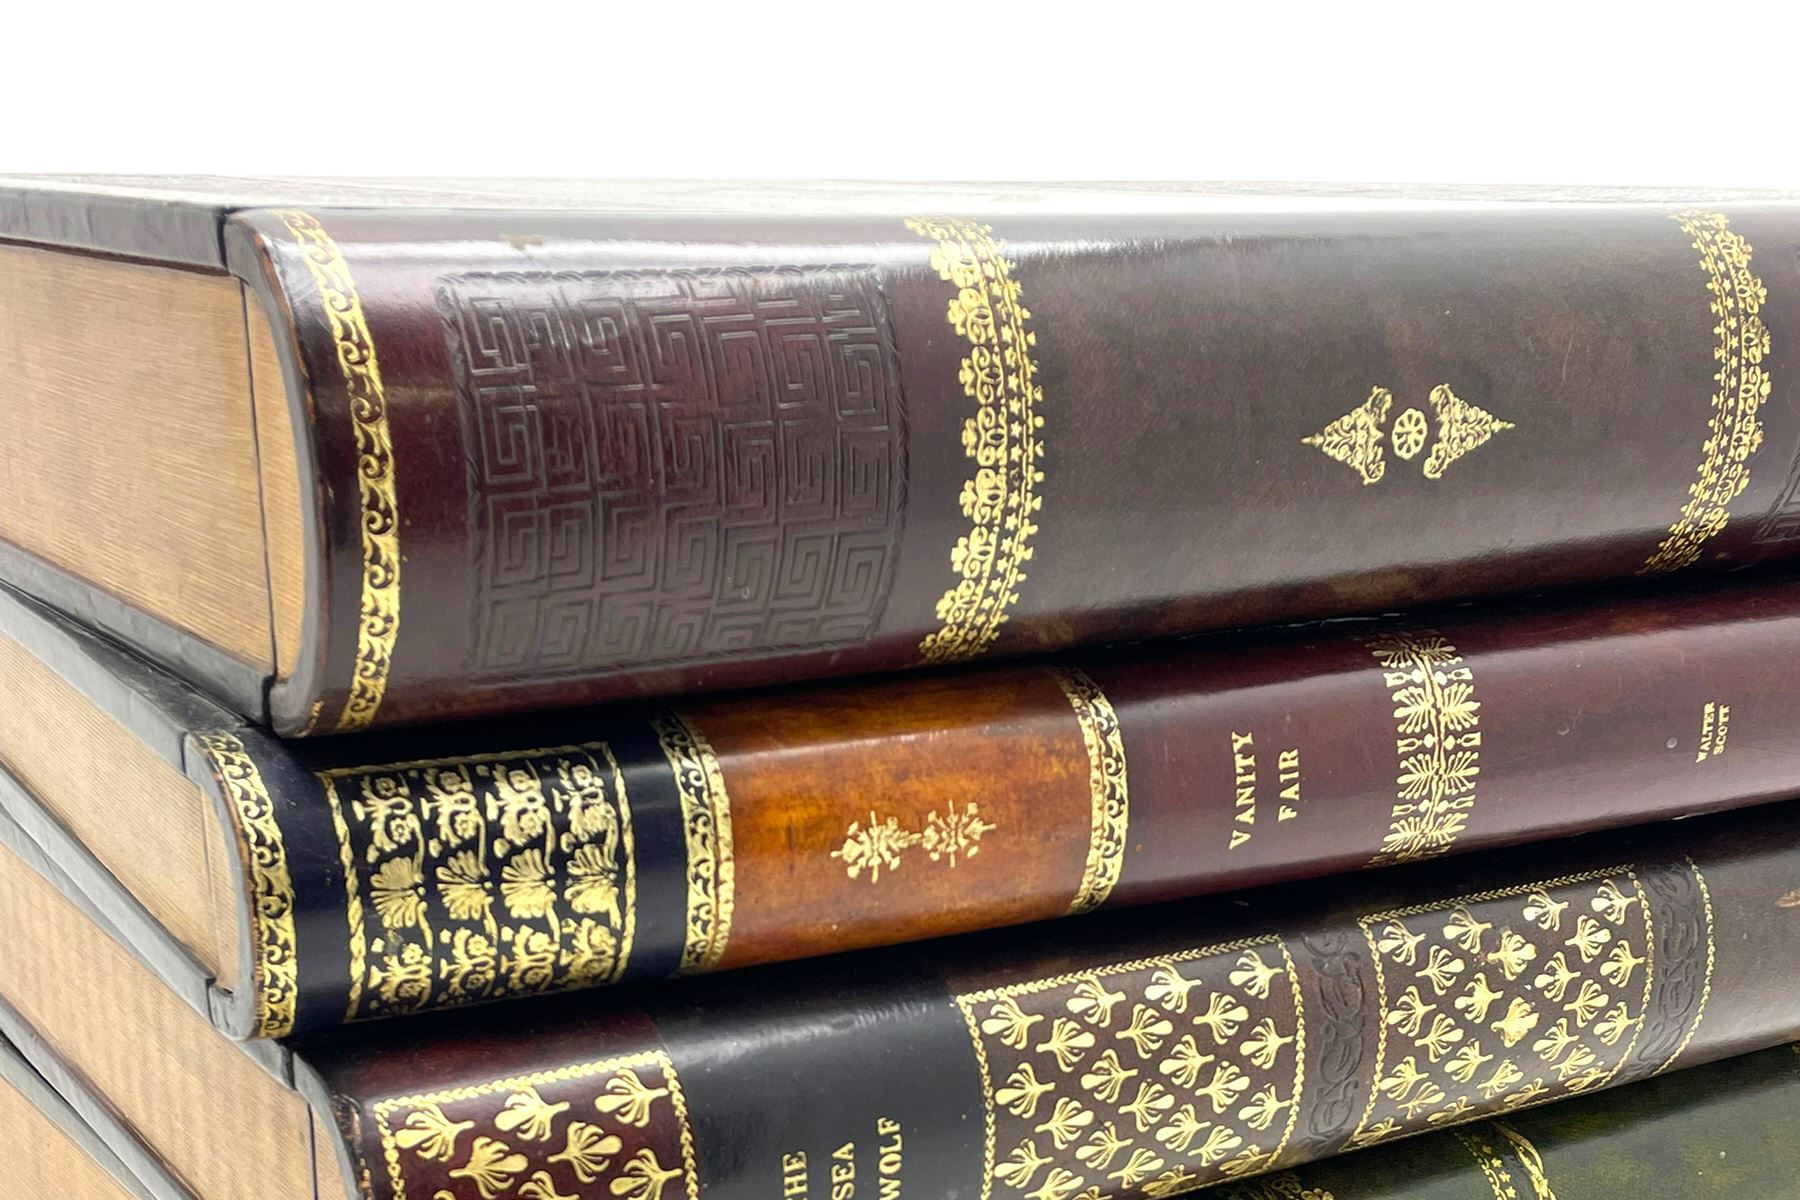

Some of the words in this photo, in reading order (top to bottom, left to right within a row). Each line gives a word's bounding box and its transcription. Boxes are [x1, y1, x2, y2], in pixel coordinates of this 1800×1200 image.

[1695, 701, 1715, 763] WALTER
[1712, 704, 1730, 755] SCOTT
[1228, 730, 1256, 850] VANITY
[1277, 748, 1300, 822] FAIR
